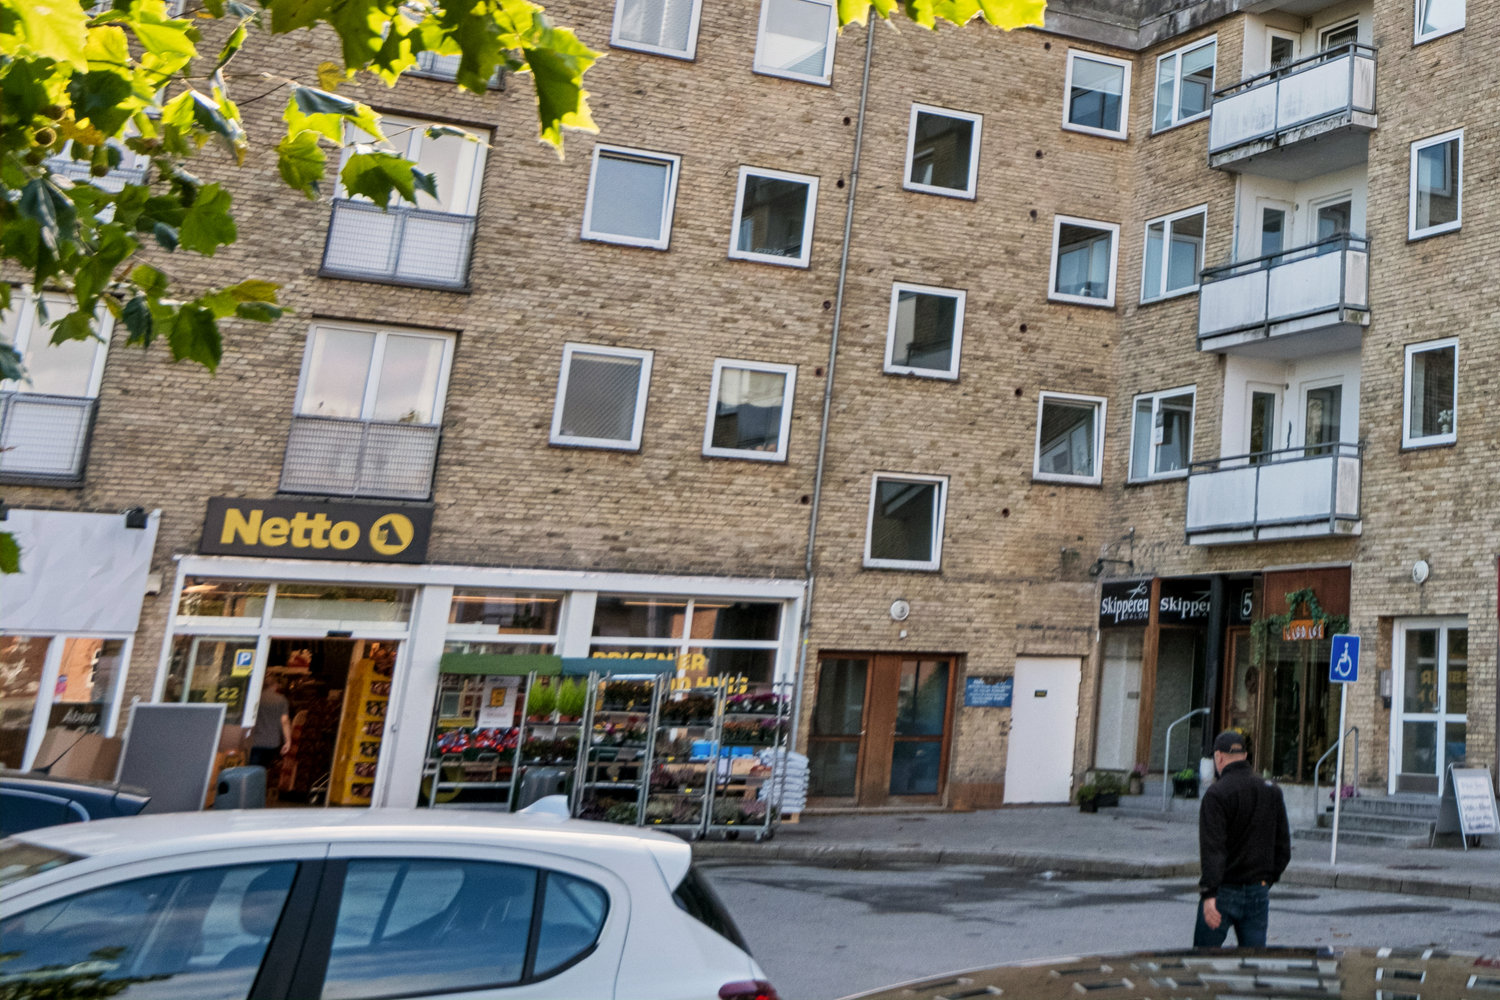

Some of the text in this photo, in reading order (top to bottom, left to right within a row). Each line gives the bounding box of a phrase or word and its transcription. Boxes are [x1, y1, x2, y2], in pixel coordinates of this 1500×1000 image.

[219, 508, 361, 550] Netto
[1101, 596, 1149, 624] Skipperen
[1242, 592, 1252, 616] 5
